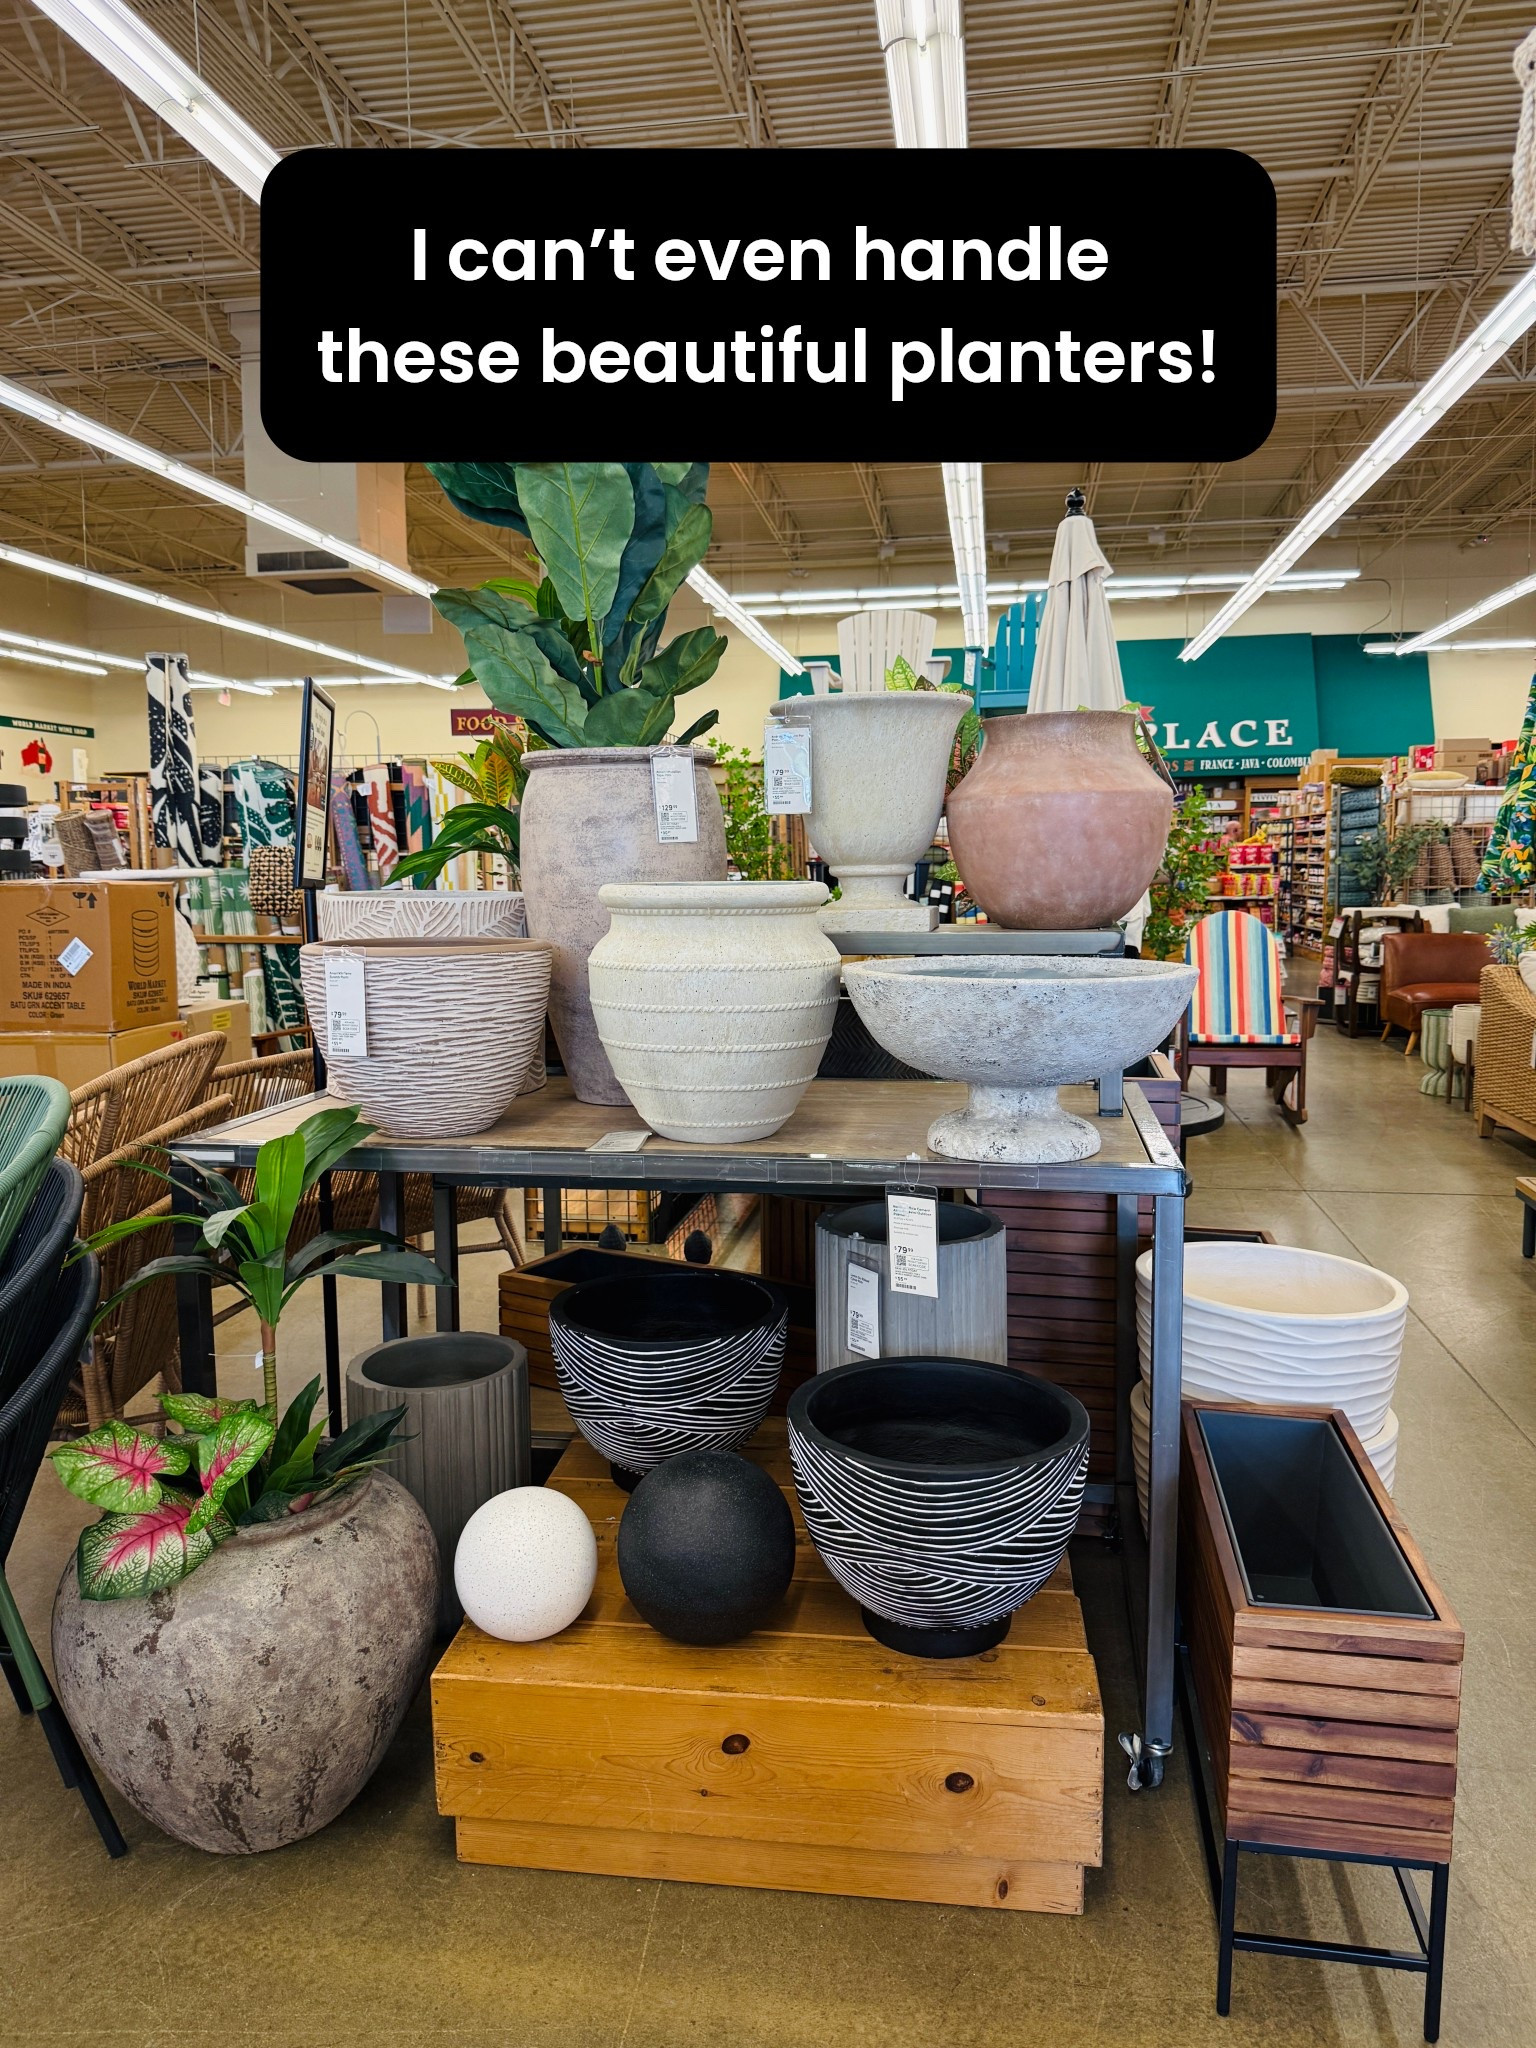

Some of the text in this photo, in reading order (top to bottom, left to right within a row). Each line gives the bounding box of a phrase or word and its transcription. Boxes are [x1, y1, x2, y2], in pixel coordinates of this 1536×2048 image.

[1200, 759, 1234, 770] FRANCE
[1240, 759, 1260, 770] JAVA
[22, 992, 43, 1000] SKU#
[10, 1001, 26, 1009] BATU
[66, 1002, 85, 1010] TABLE
